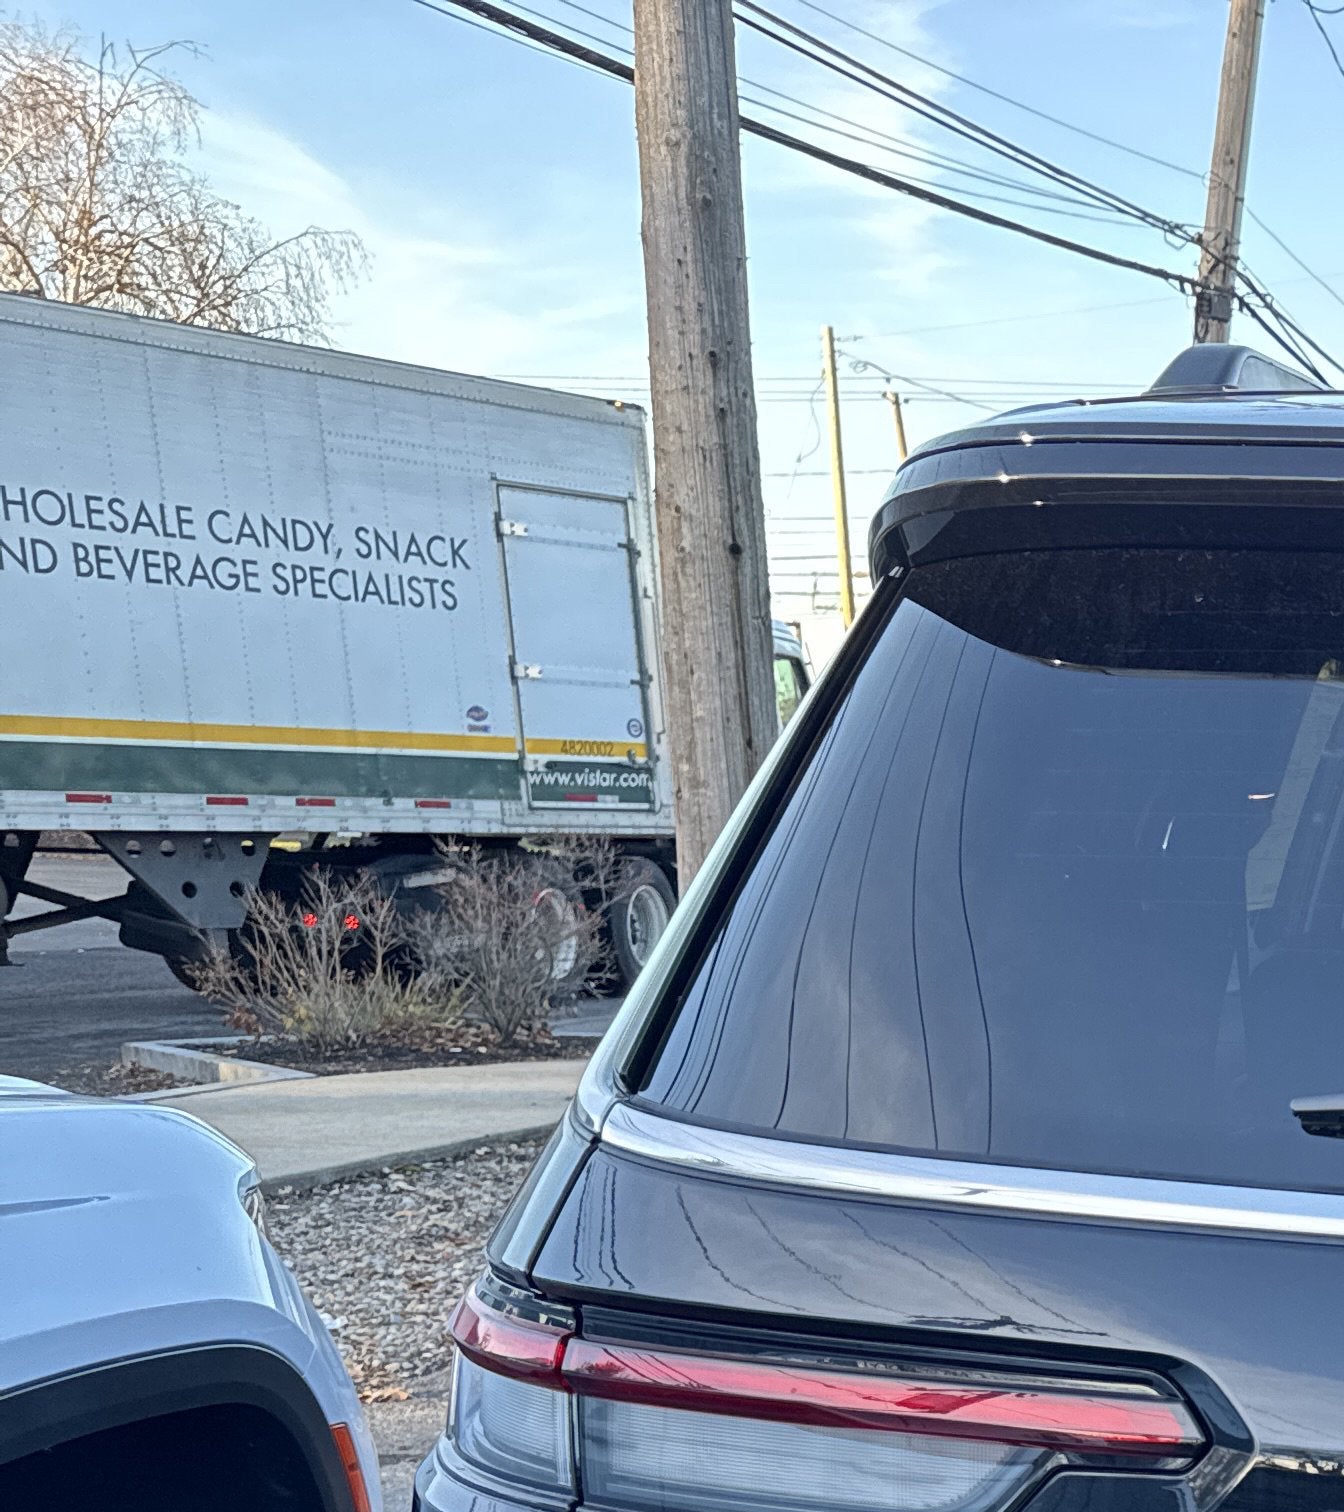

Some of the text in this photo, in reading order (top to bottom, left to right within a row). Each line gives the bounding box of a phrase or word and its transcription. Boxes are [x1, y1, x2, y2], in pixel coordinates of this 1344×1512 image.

[0, 485, 471, 570] HOLESALE CANDY, SNACK
[0, 537, 458, 611] ND BEVERAGE SPECIALISTS
